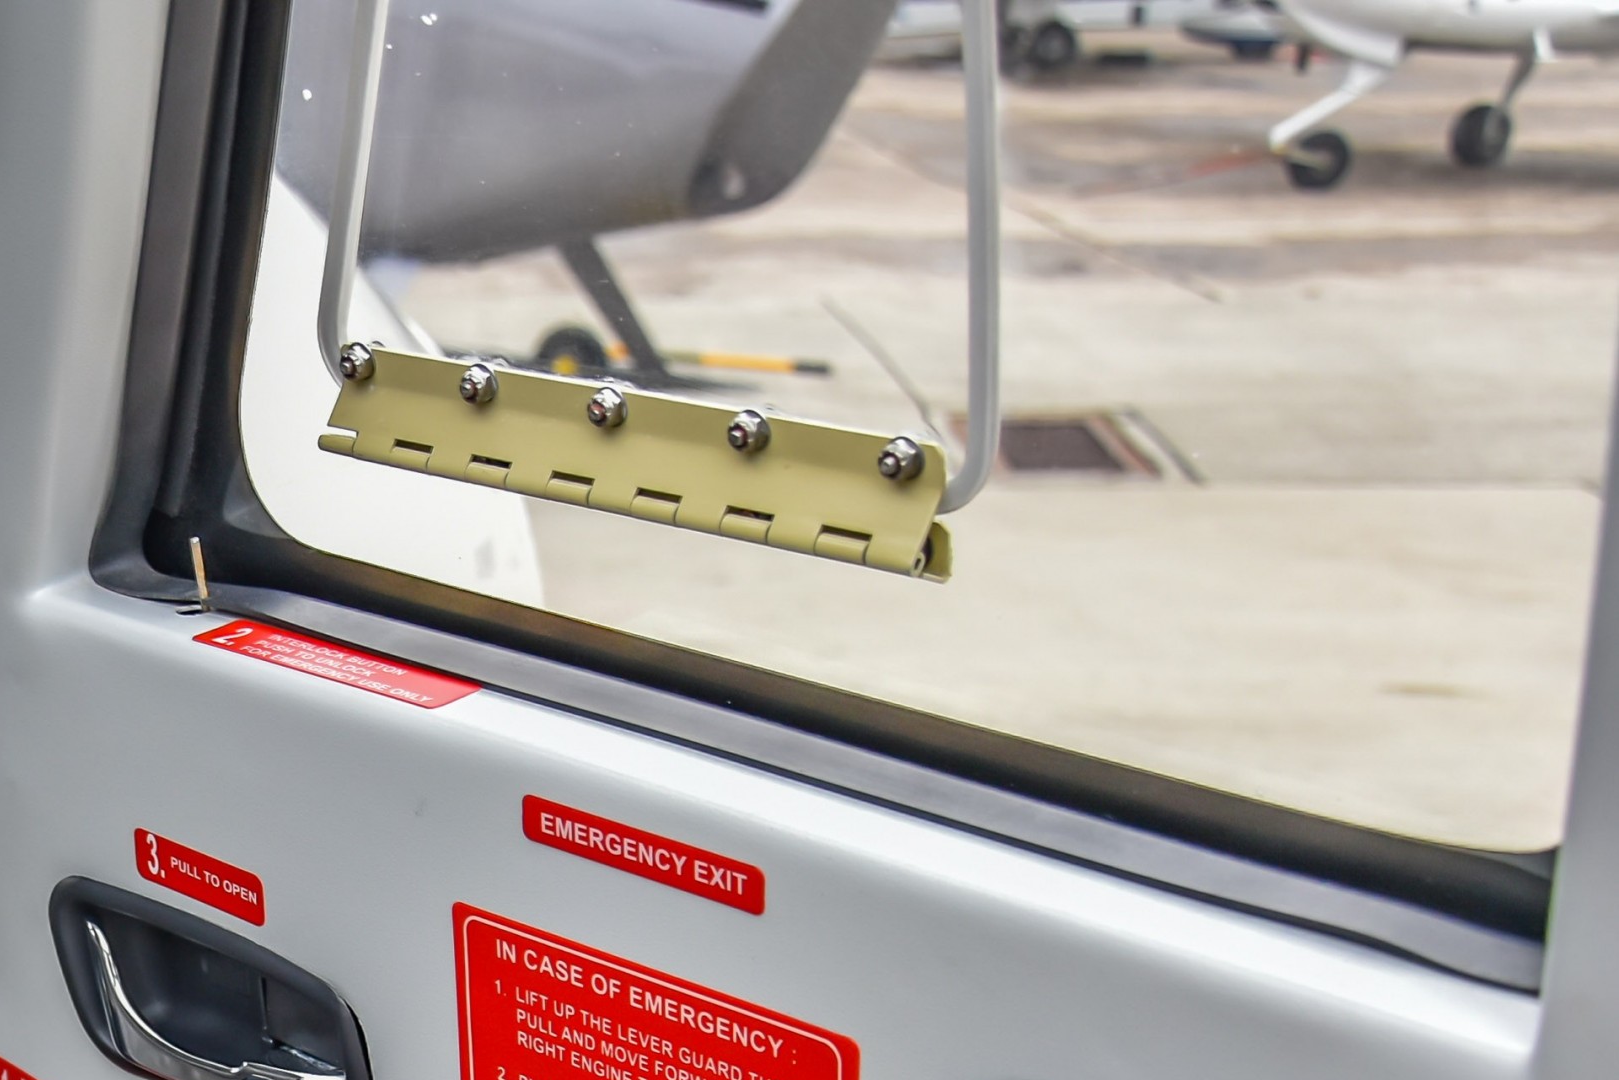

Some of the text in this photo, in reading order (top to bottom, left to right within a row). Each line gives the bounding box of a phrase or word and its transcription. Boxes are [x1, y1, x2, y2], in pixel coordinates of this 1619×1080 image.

[211, 627, 253, 646] 2.
[256, 640, 375, 678] PUSH TO UNLOCK
[269, 634, 408, 677] INTERLOCK BUTTON
[241, 645, 434, 703] FOR EMERGENCY USE ONLY
[146, 833, 166, 879] 3.
[540, 812, 748, 896] EMERGENCY EXIT
[170, 856, 258, 906] PULL TO OPEN
[494, 979, 507, 997] 1.
[515, 986, 549, 1011] LIFT
[553, 1000, 576, 1020] UP
[580, 1009, 612, 1036] THE
[617, 1023, 674, 1058] LEVER
[495, 938, 517, 964] IN
[523, 948, 584, 988] CASE
[590, 973, 622, 999] OF
[629, 985, 784, 1058] EMERGENCY
[516, 1008, 558, 1038] PULL
[561, 1026, 596, 1051] AND
[600, 1040, 649, 1072] MOVE
[517, 1030, 566, 1062] RIGHT
